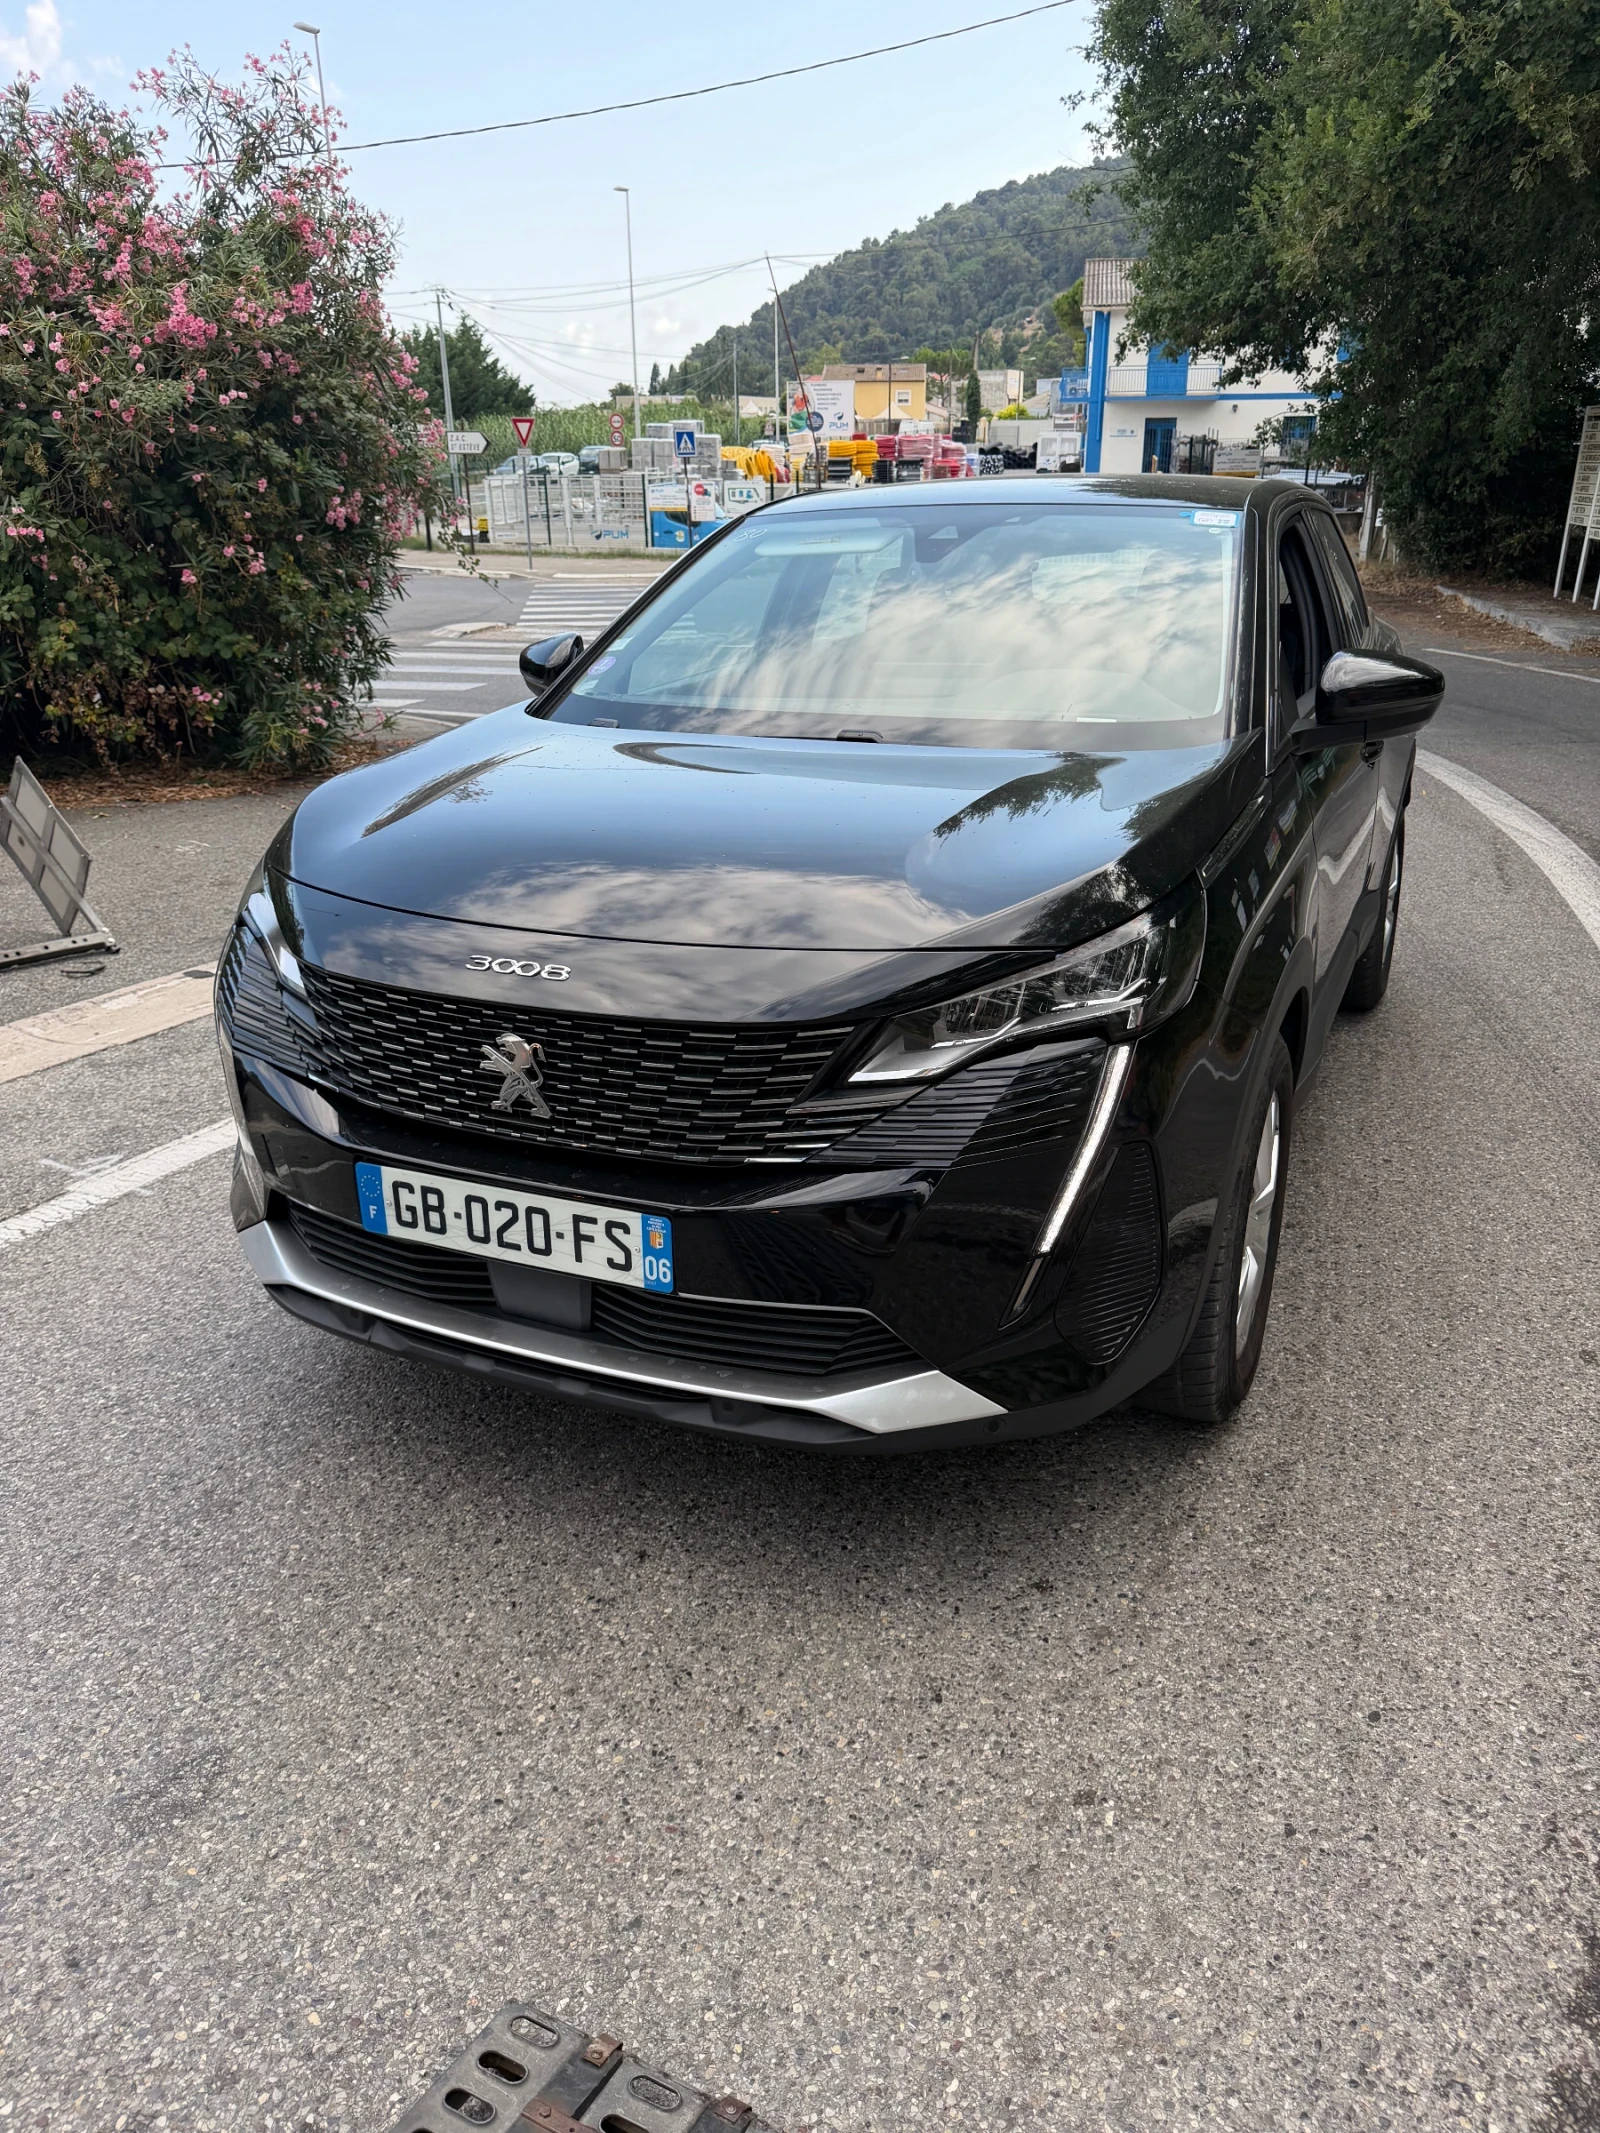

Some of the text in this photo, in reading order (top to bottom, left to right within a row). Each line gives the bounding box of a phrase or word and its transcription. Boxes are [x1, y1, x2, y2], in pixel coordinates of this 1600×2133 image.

[603, 530, 629, 539] PUM
[465, 954, 572, 981] 3008
[369, 1205, 378, 1219] F
[391, 1180, 633, 1273] GB-020-FS
[645, 1255, 671, 1284] 06
